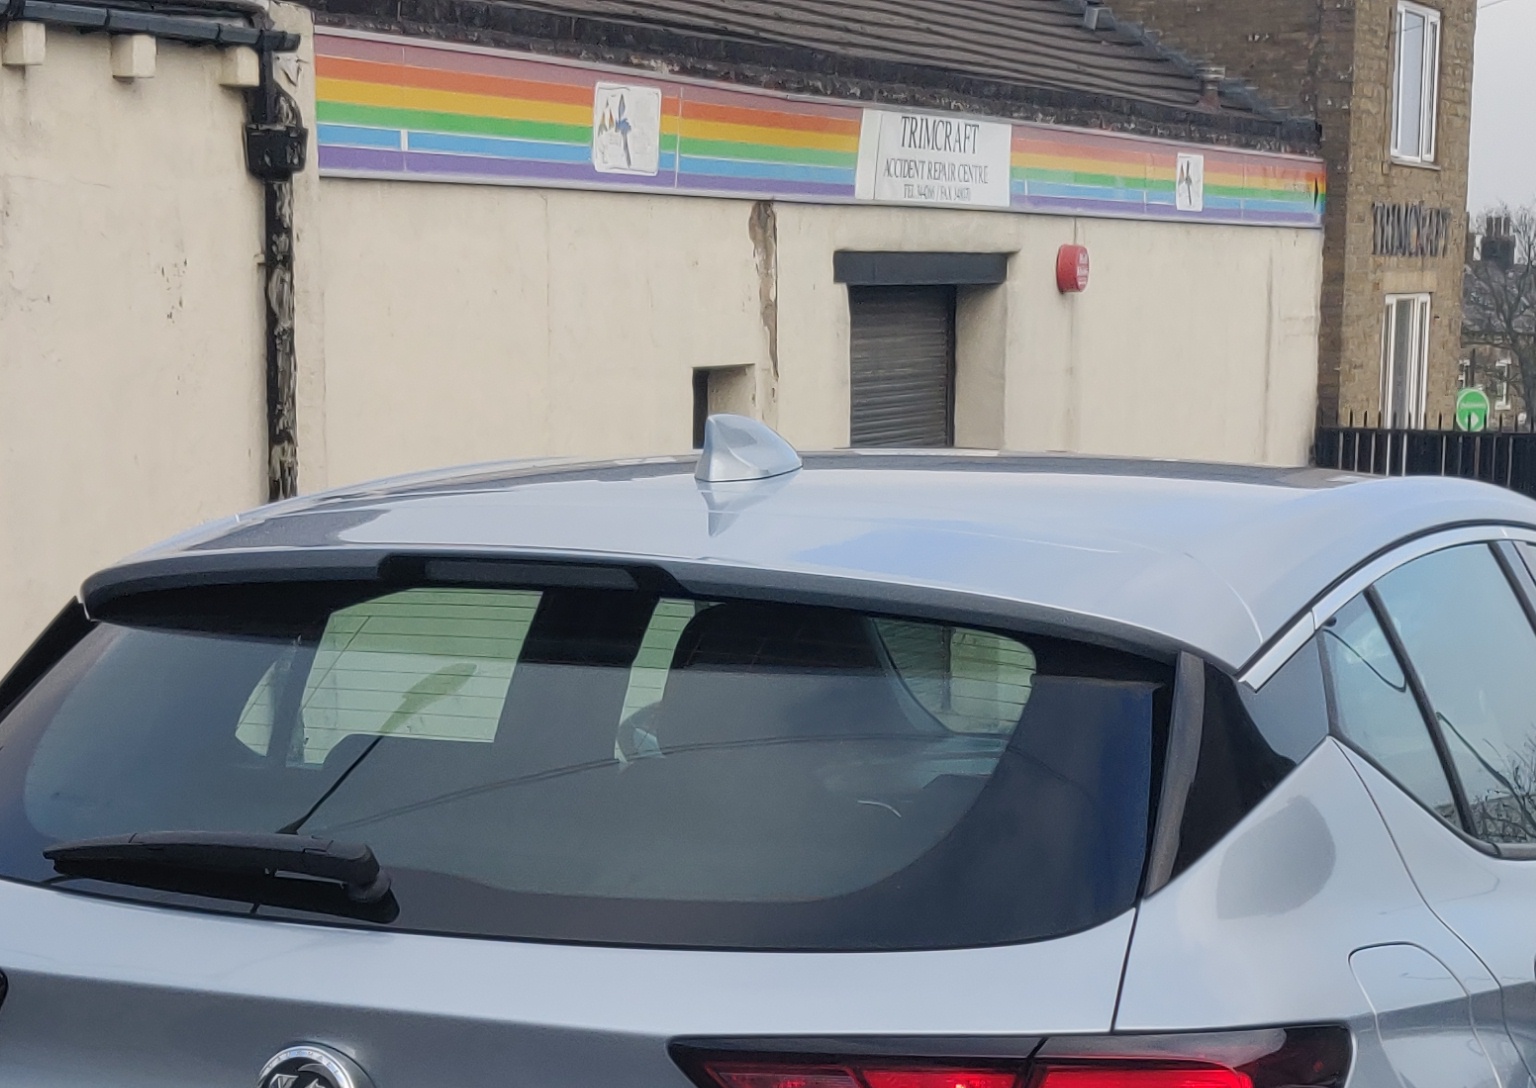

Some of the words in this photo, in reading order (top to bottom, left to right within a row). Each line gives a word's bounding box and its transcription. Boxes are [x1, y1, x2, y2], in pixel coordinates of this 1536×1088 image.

[901, 116, 980, 154] TRIMCRAFT
[883, 158, 926, 179] ACCIDENT
[927, 161, 956, 182] REPAIR
[958, 164, 989, 184] CENTRE
